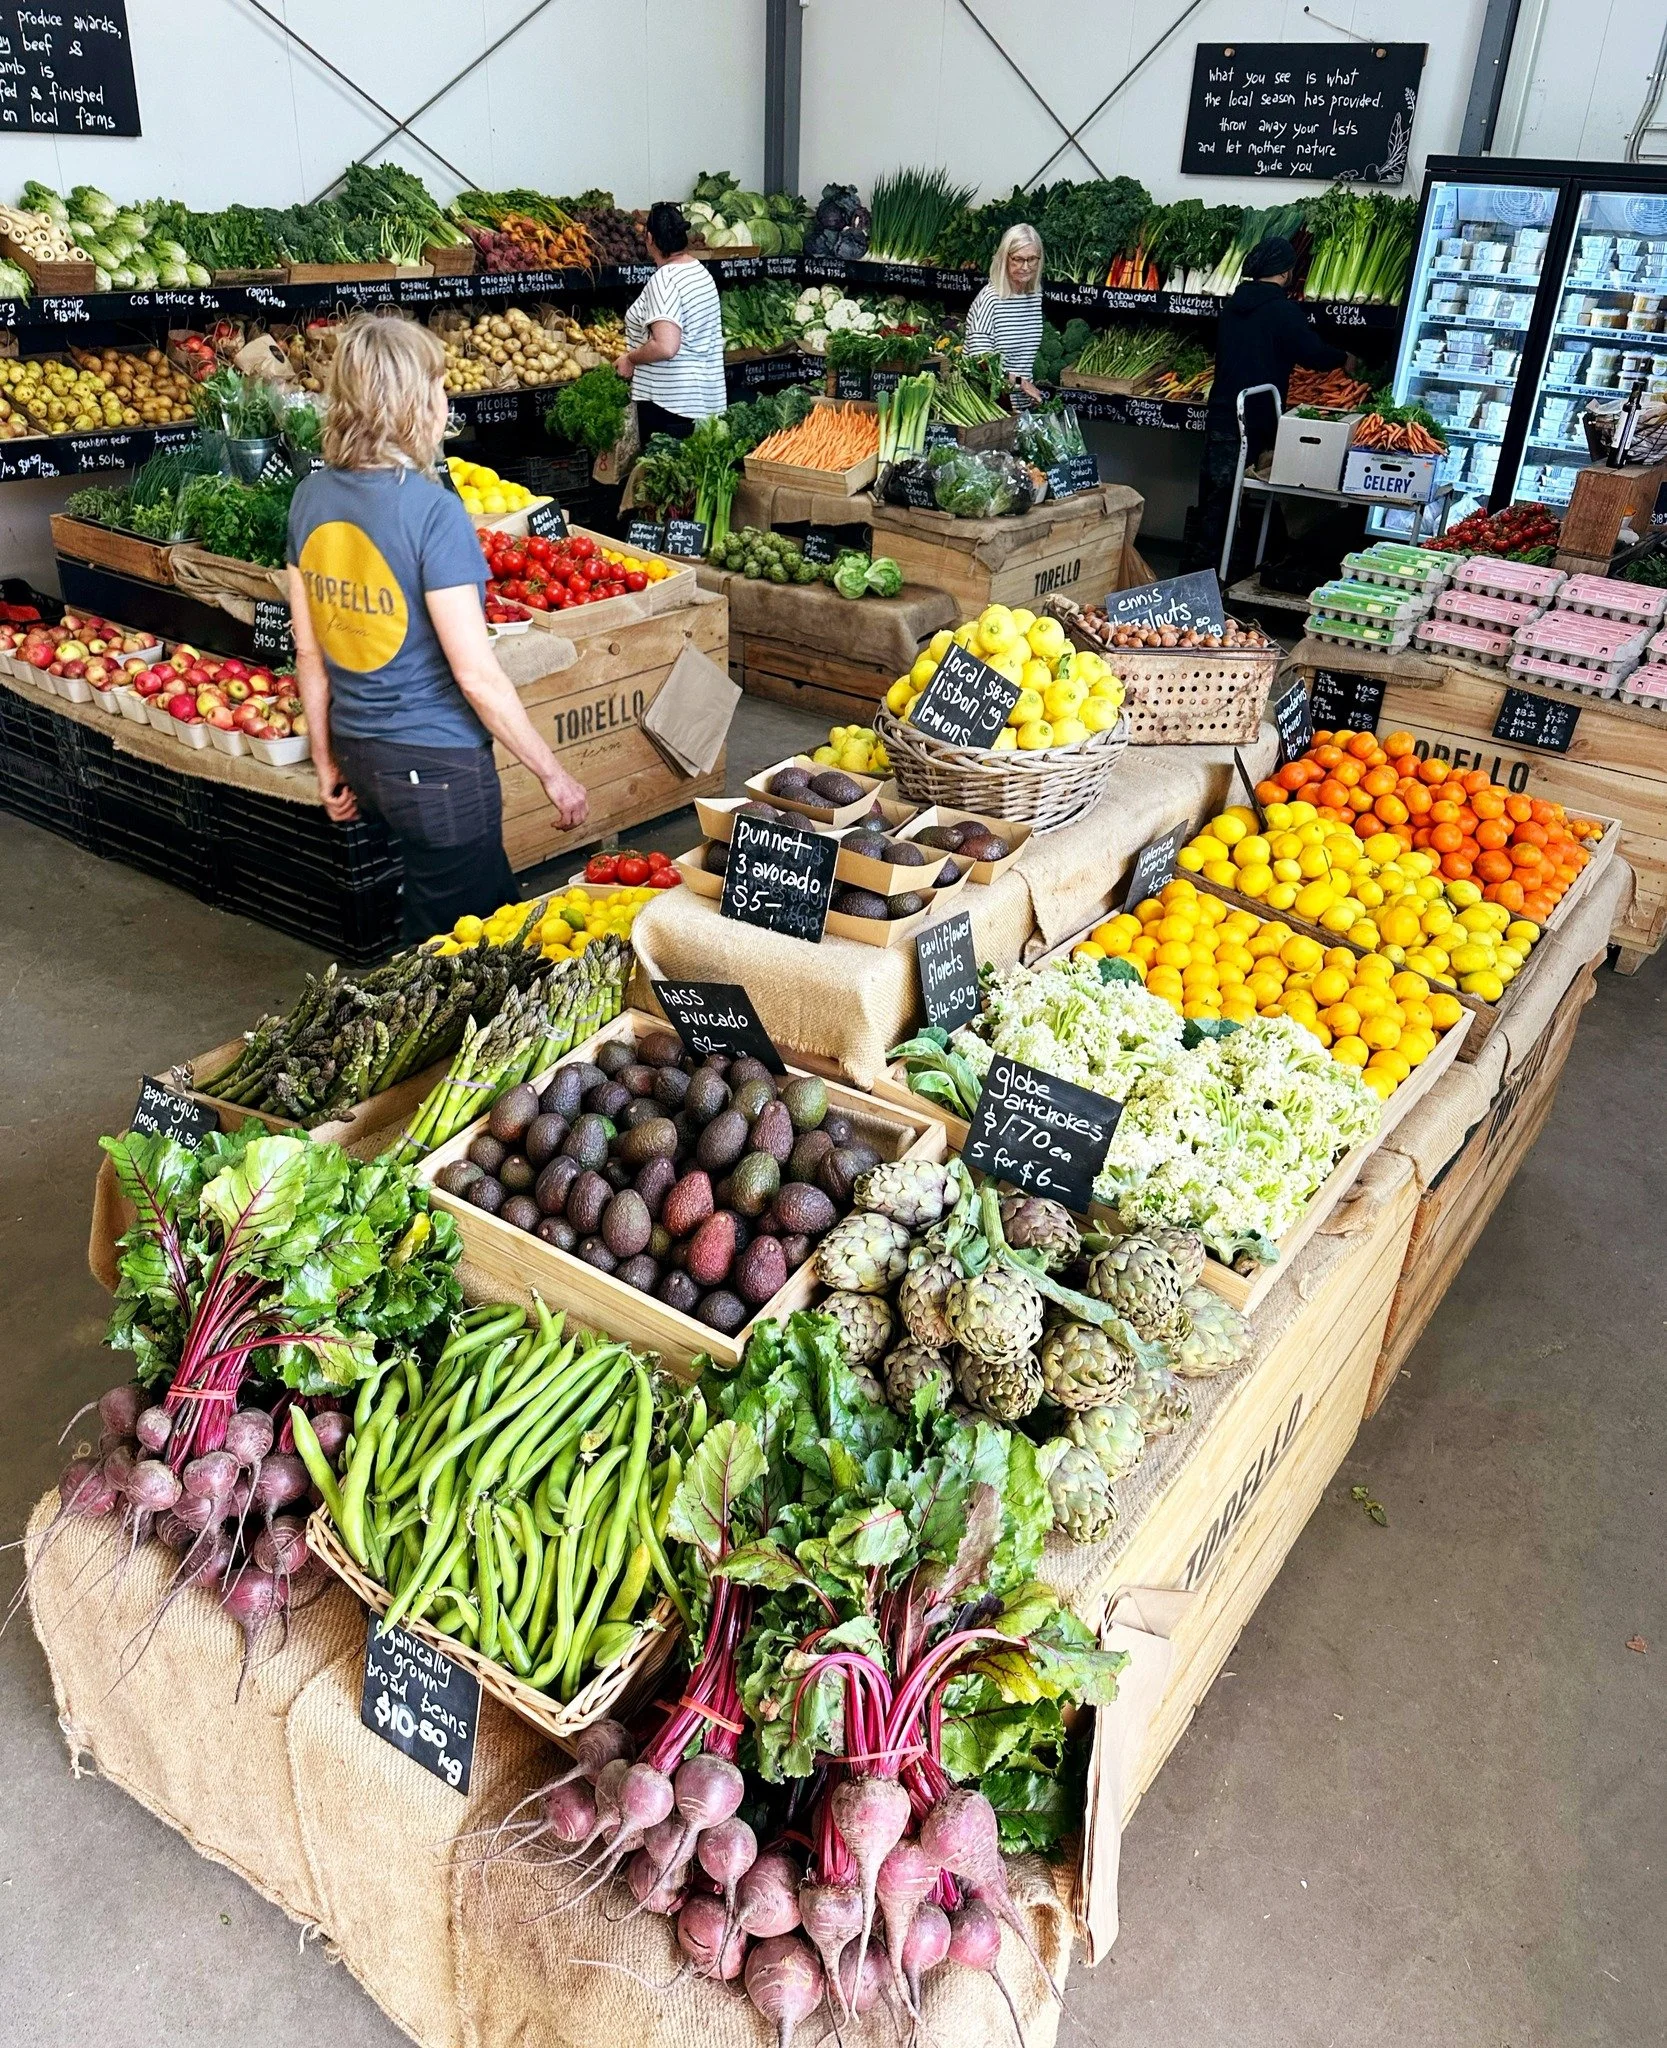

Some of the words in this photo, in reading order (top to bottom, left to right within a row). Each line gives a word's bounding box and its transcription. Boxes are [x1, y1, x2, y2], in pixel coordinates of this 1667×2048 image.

[17, 9, 63, 31] produce
[73, 15, 122, 39] awards,
[22, 33, 53, 56] beef
[68, 40, 83, 57] &
[0, 57, 26, 75] amb
[39, 62, 55, 78] is
[1242, 72, 1265, 88] you
[1274, 71, 1291, 84] see
[1306, 70, 1317, 83] is
[1326, 68, 1359, 87] what
[30, 85, 42, 101] &
[49, 81, 104, 105] finished
[1204, 93, 1221, 107] the
[1228, 90, 1253, 108] local
[1260, 93, 1296, 106] season
[1304, 91, 1325, 107] has
[1329, 92, 1384, 116] provided.
[2, 110, 18, 123] on
[30, 104, 58, 126] local
[75, 106, 116, 129] farms
[1219, 117, 1247, 131] throw
[1258, 121, 1287, 139] away
[1292, 123, 1320, 139] your
[1332, 119, 1358, 136] lists
[1198, 141, 1215, 154] and
[1226, 139, 1242, 154] let
[1248, 140, 1286, 155] mother
[1296, 138, 1337, 157] nature
[1254, 159, 1283, 175] guide
[1290, 159, 1314, 176] you.
[336, 285, 357, 297] baby
[359, 282, 391, 293] broccoli
[526, 272, 554, 286] golden
[43, 297, 84, 313] parsnip
[130, 295, 149, 306] cos
[155, 293, 195, 305] lettuce
[246, 285, 273, 302] rapini
[1103, 290, 1133, 301] rainbow
[1170, 295, 1214, 309] Silverbeet
[1325, 304, 1359, 318] Celery
[1335, 315, 1347, 325] $2
[154, 431, 185, 444] beurre
[1363, 475, 1412, 494] CELERY
[1034, 558, 1080, 597] TORELLO
[303, 571, 394, 616] TORELLO
[1118, 587, 1163, 611] ennis
[256, 601, 285, 619] organic
[255, 615, 283, 630] apples
[1207, 624, 1223, 638] kg
[943, 645, 987, 689] local
[930, 670, 980, 719] lisbon
[983, 675, 1016, 709] $8.50
[553, 689, 645, 744] TORELLO
[917, 694, 971, 748] lemons
[1509, 726, 1525, 738] $15
[735, 853, 747, 874] 3
[752, 861, 821, 894] avocado
[920, 919, 970, 959] cauliflower
[928, 949, 964, 991] florets
[658, 985, 704, 1006] hass
[679, 1007, 748, 1029] avocado
[988, 1063, 1051, 1099] globe
[143, 1084, 200, 1124] asparagus
[134, 1106, 159, 1131] loose
[1003, 1093, 1104, 1142] artichokes
[971, 1141, 991, 1158] 5
[993, 1147, 1018, 1169] for
[1185, 1392, 1304, 1590] TORELLO
[375, 1619, 452, 1688] oganically
[388, 1653, 439, 1693] grown
[374, 1690, 448, 1748] $10.50
[421, 1692, 467, 1739] beans
[437, 1750, 463, 1787] kg
